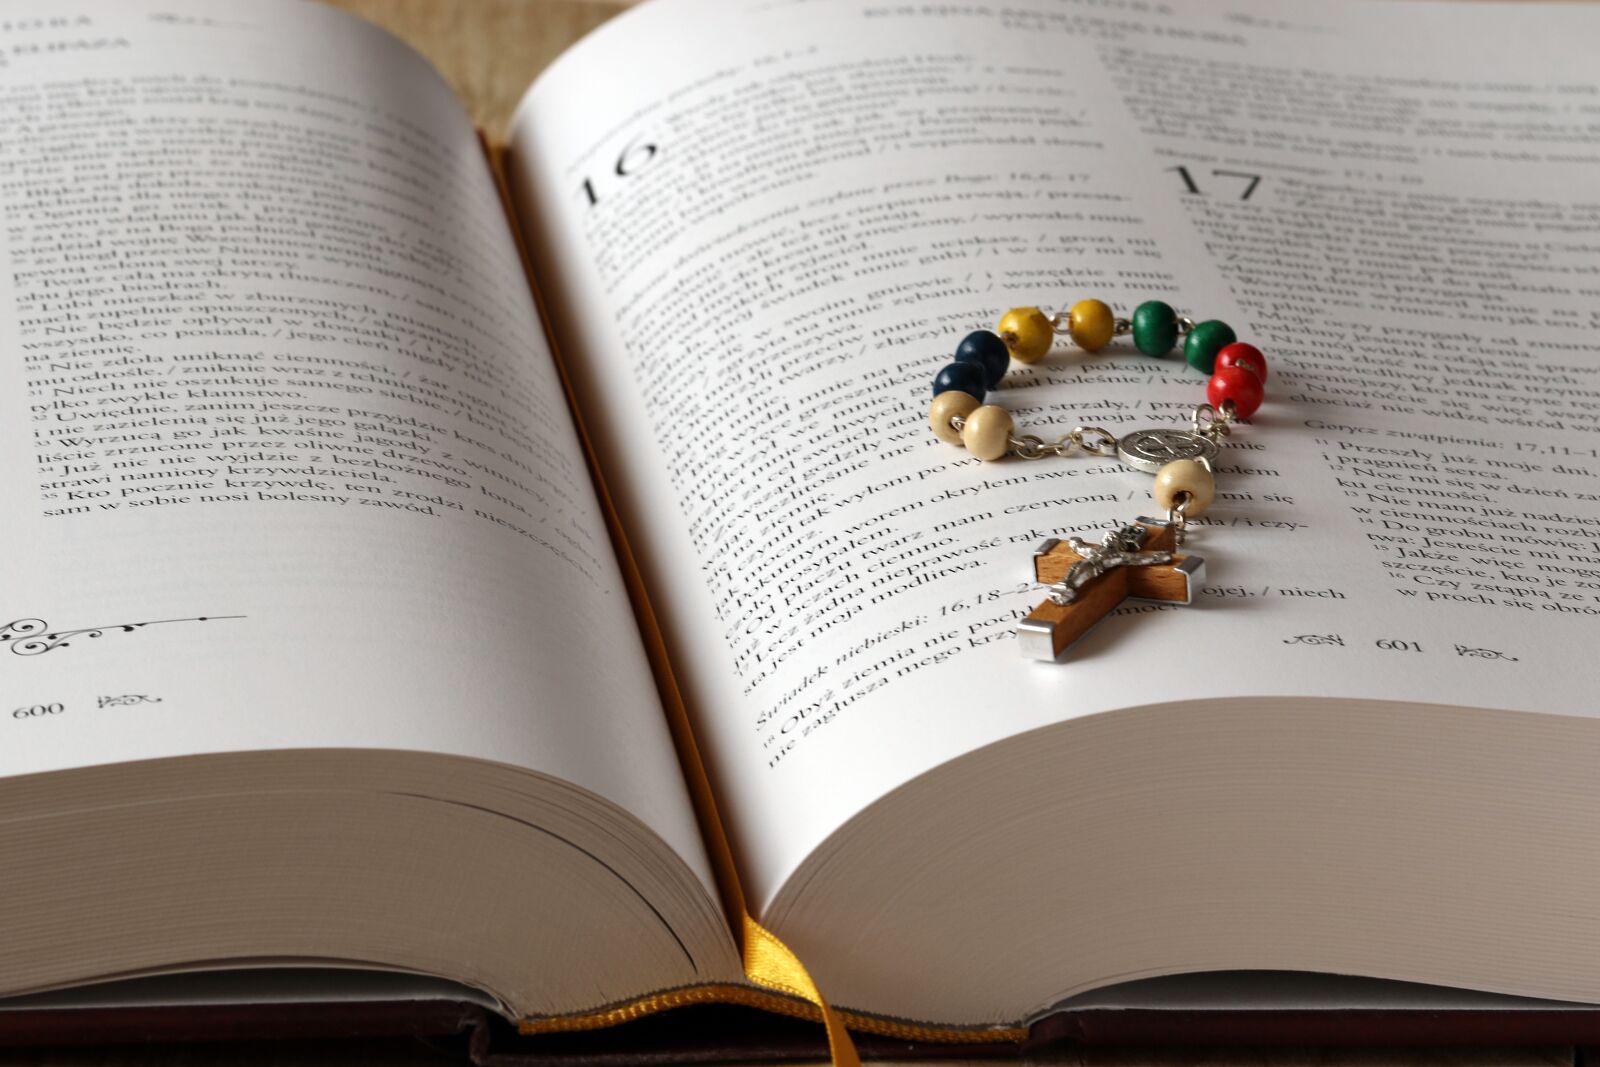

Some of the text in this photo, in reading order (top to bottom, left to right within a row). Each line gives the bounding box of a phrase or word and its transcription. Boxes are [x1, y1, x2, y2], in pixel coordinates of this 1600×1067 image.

[577, 132, 657, 206] 16
[1164, 165, 1262, 200] 17
[50, 362, 93, 372] Nie
[53, 376, 374, 397] Niech nie oszukuje samego
[30, 400, 89, 413] tylko
[185, 401, 256, 411] zanim
[259, 401, 341, 413] jeszcze
[1381, 404, 1415, 414] nie
[49, 426, 84, 436] nie
[93, 416, 207, 431] zazielenią
[215, 414, 247, 424] się
[251, 414, 289, 425] już
[294, 415, 347, 428] jego
[879, 445, 914, 460] me
[1078, 412, 1137, 424] moja
[1304, 419, 1503, 449] Gorycz zwątpienia:
[37, 450, 97, 464] liście
[104, 443, 213, 457] zrzucone
[222, 441, 288, 451] przez
[294, 440, 375, 455] oliwne
[58, 426, 432, 455] Wyrzucą go jak kwaśne jagody
[1337, 455, 1508, 480] pragnień serca.
[1338, 441, 1544, 472] Przeszły już moje
[40, 465, 398, 490] strawi namioty krzywdziciela.
[60, 462, 102, 477] Już
[159, 455, 197, 465] nie
[206, 451, 299, 464] wyjdzie
[332, 454, 473, 491] bezbożnego
[1352, 466, 1570, 498] Noc mi się w dzień
[67, 478, 465, 511] Kto pocznie krzywdę, ten zrodzi
[800, 508, 830, 527] tak
[918, 466, 946, 480] po
[844, 501, 924, 533] worem
[930, 477, 1028, 503] okryłem
[1034, 469, 1078, 480] swe
[1335, 477, 1498, 503] ku ciemności.
[43, 491, 441, 517] sam w sobie nosi bolesny zawód.
[1367, 493, 1517, 518] Nie mam już
[1350, 506, 1536, 532] w ciemnościach
[1367, 533, 1560, 560] twa: Jesteście mi
[1382, 519, 1586, 551] Do grobu mówię:
[746, 604, 776, 635] Od
[861, 531, 922, 560] twarz
[933, 511, 993, 532] mam
[1003, 494, 1119, 514] czerwoną
[1222, 492, 1253, 501] mi
[1263, 493, 1294, 504] się
[871, 537, 1003, 588] nieprawość
[1009, 529, 1046, 543] rąk
[1396, 547, 1525, 569] Jakże więc
[788, 537, 961, 618] oczach ciemno.
[1382, 561, 1567, 588] szczęście, kto je
[1414, 575, 1584, 601] Czy zstąpią ze
[811, 607, 862, 639] moja
[871, 560, 989, 605] modlitwa.
[1396, 588, 1534, 611] w proch się
[837, 615, 928, 667] niebieski:
[842, 648, 914, 691] ziemia
[923, 630, 959, 648] nie
[1280, 587, 1347, 599] niech
[1375, 639, 1424, 653] 601
[12, 702, 65, 719] 600
[768, 740, 797, 769] nie
[896, 646, 962, 677] mego
